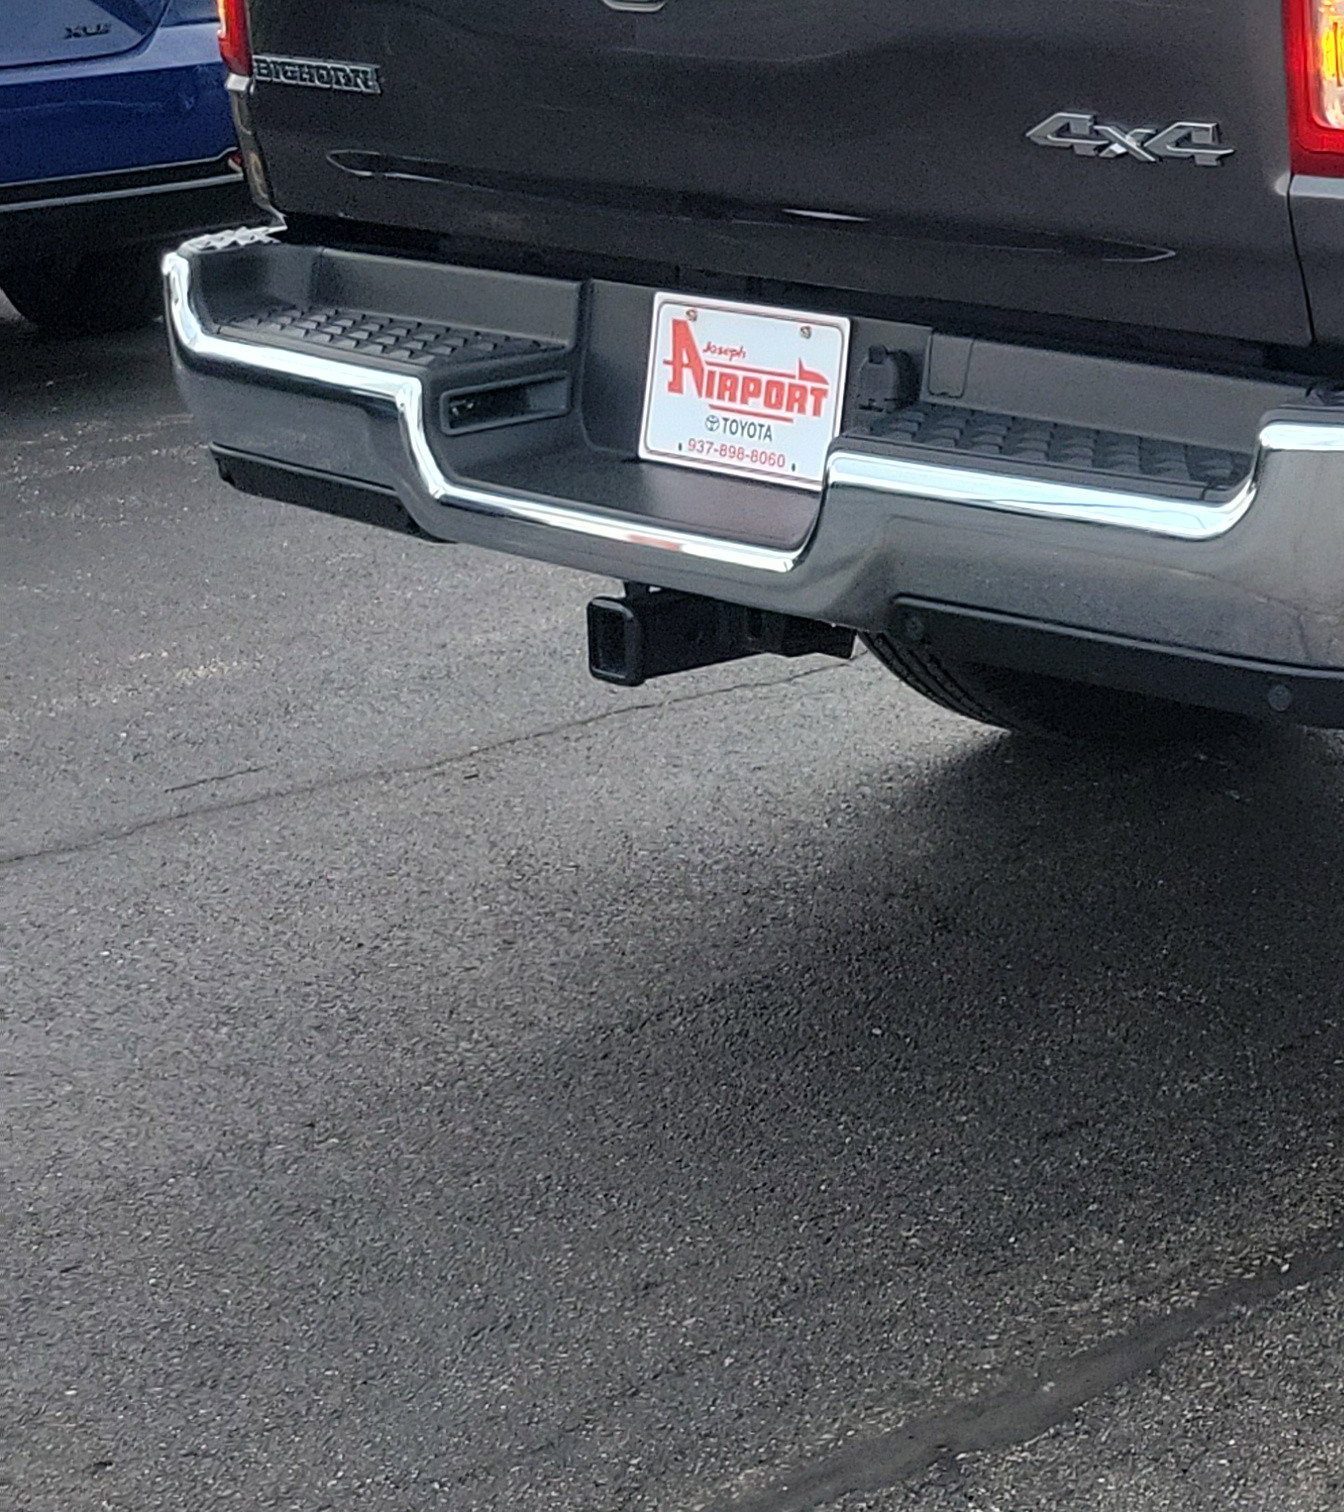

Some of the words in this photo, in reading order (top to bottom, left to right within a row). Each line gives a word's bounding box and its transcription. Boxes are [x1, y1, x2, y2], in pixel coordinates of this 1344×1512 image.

[703, 342, 746, 361] Joseph
[665, 318, 829, 417] AIRPORT
[722, 417, 772, 441] TOYOTA
[687, 438, 786, 468] 937-898-8060
